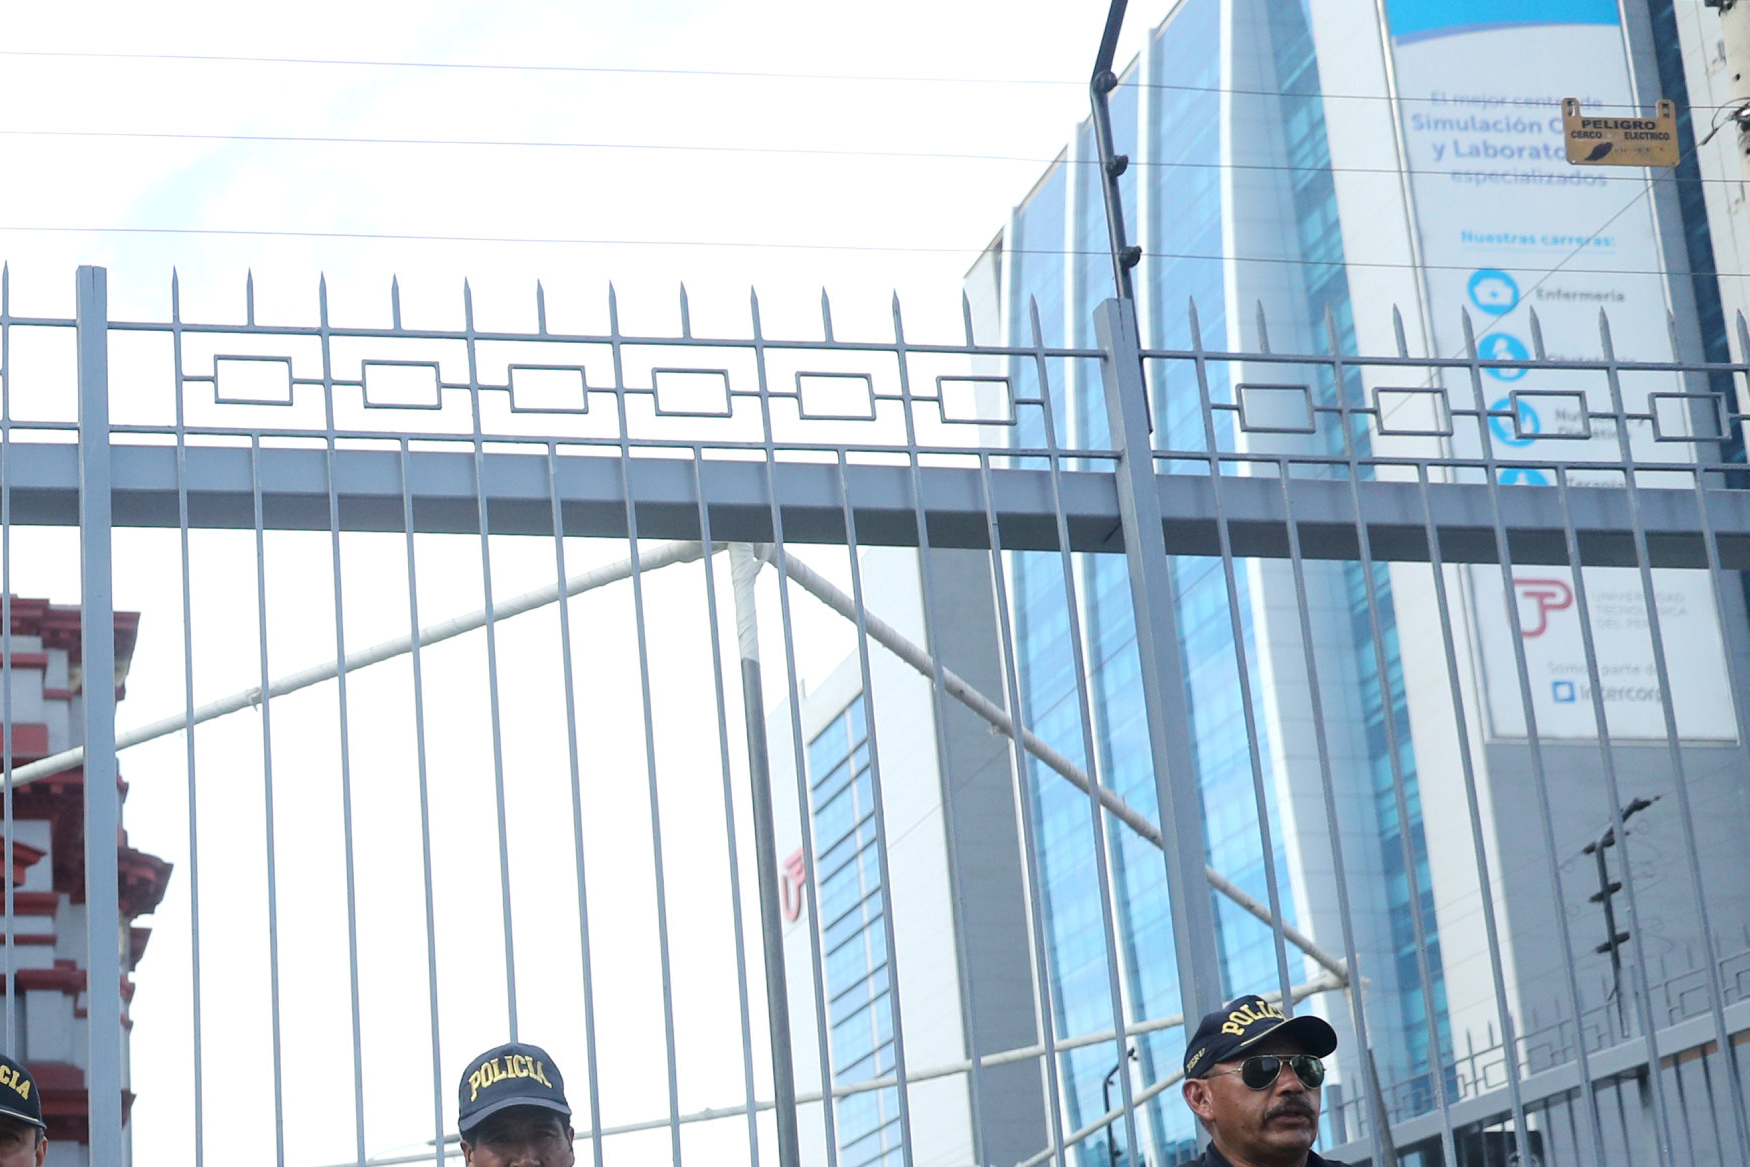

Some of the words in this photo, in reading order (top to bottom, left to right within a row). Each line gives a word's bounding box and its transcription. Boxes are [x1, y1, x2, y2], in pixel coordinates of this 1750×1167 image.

[1512, 94, 1563, 108] centr
[1411, 113, 1543, 134] Simulación
[1581, 120, 1656, 130] PELIGRO
[1570, 130, 1602, 139] CERCO
[1624, 131, 1670, 140] ELECTRICO
[1431, 143, 1446, 163] y
[1453, 138, 1566, 160] Laborato
[1461, 229, 1536, 245] Nuestras
[1540, 234, 1616, 248] carreras:
[468, 1054, 553, 1102] POLICIA
